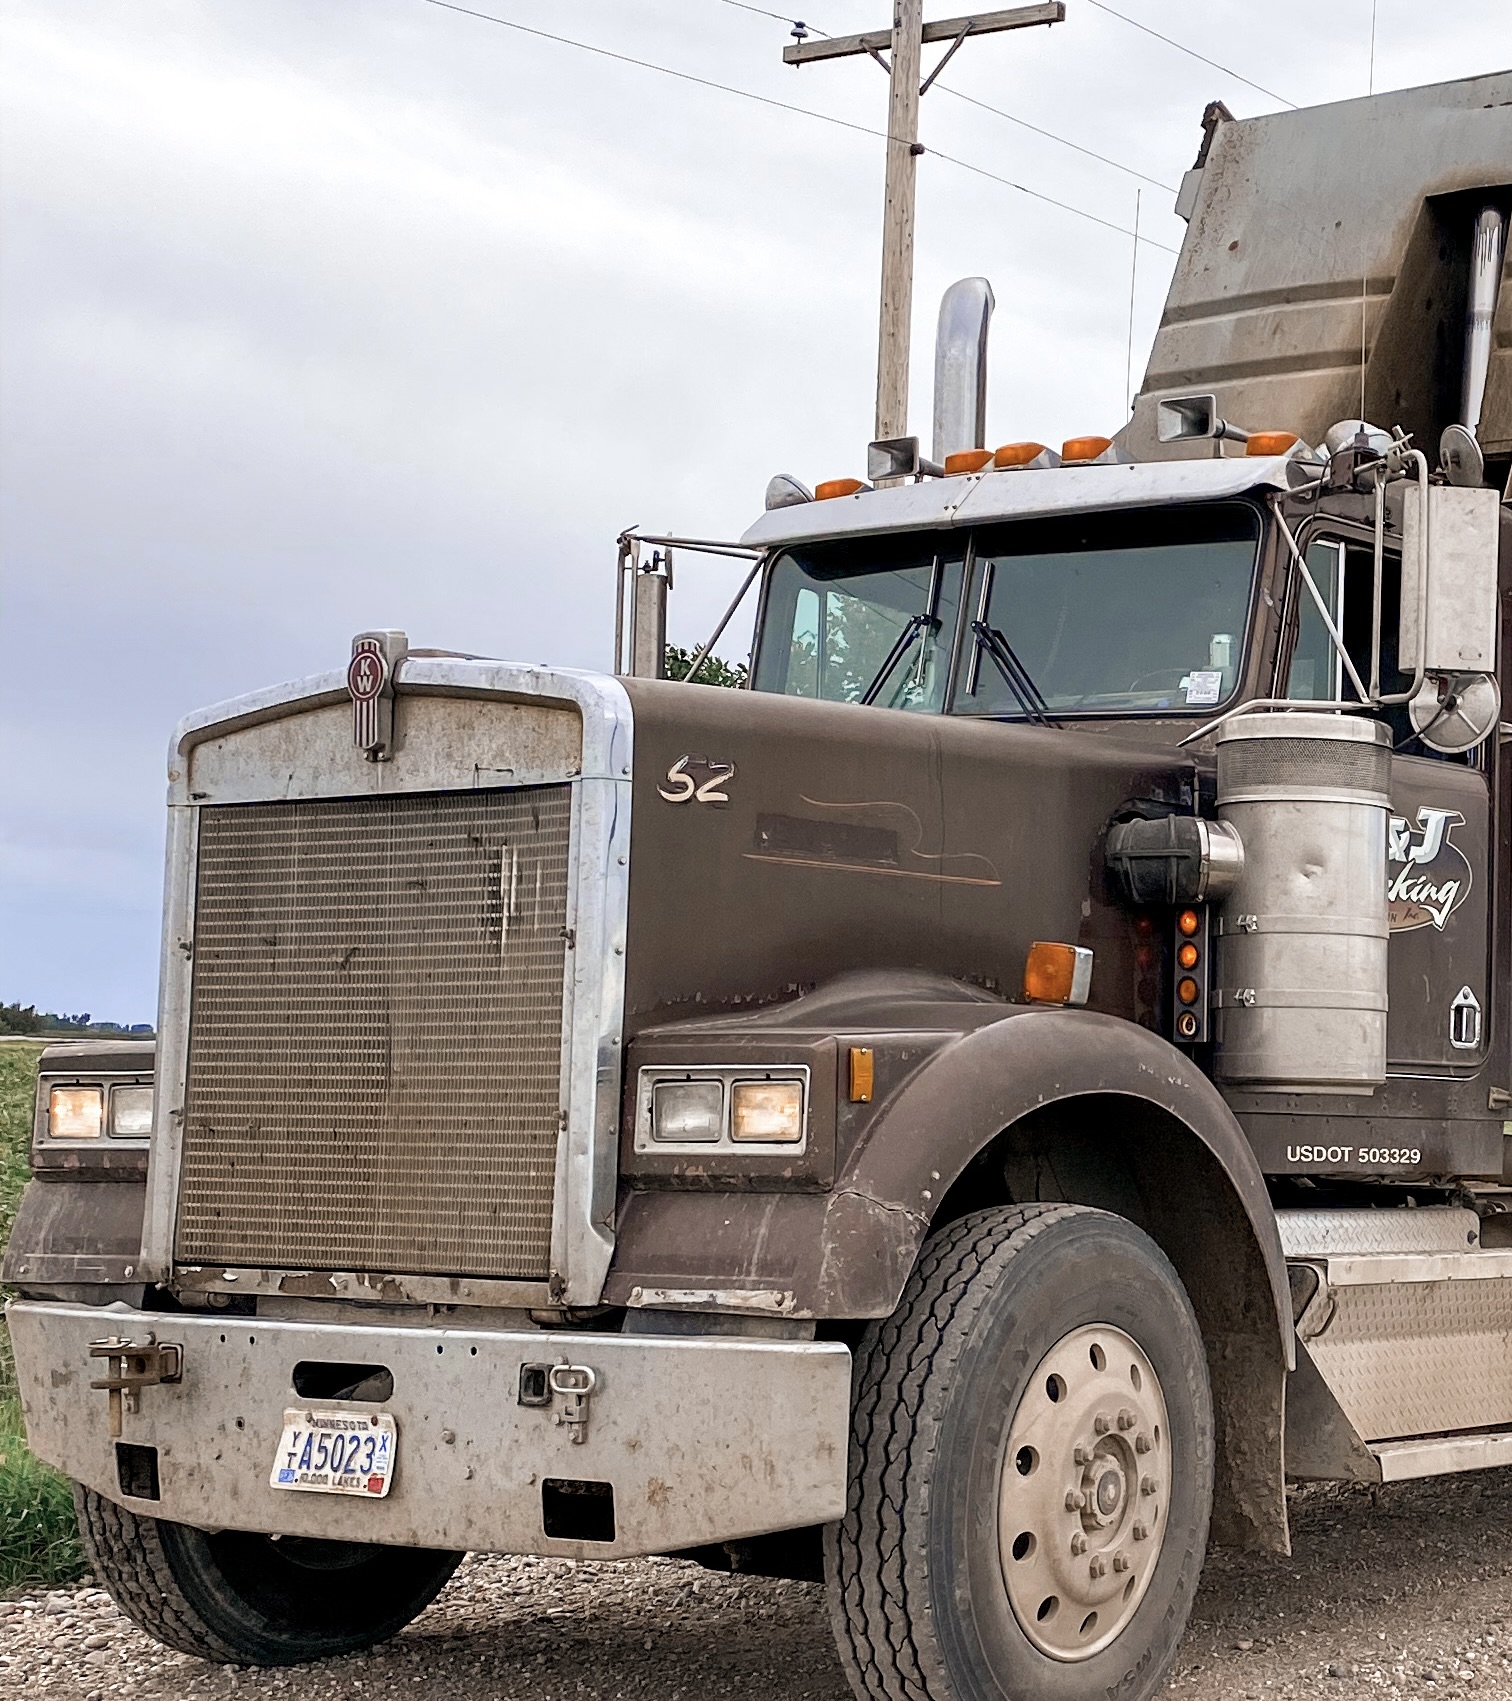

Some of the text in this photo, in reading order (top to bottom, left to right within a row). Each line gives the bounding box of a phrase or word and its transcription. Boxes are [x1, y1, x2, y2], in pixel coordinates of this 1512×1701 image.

[1388, 858, 1461, 928] king
[1286, 1145, 1422, 1164] USDOT 503329
